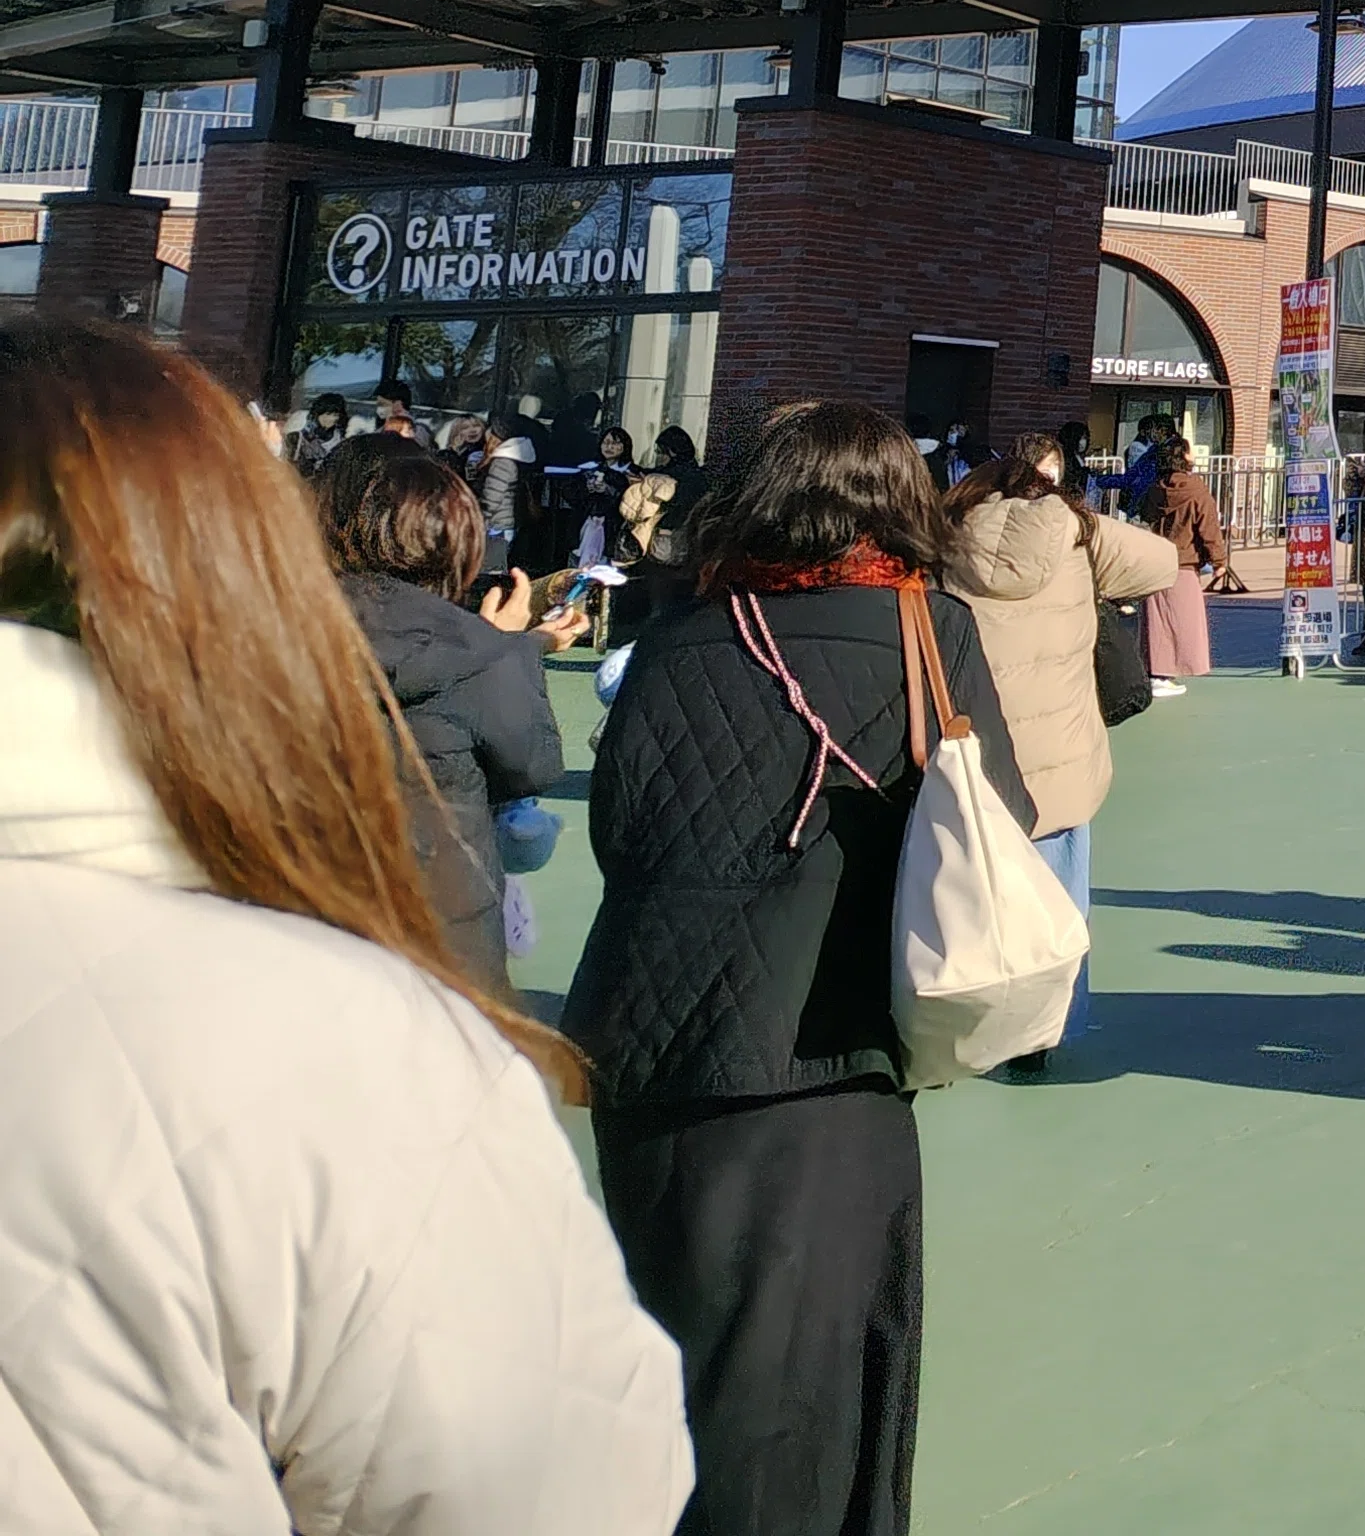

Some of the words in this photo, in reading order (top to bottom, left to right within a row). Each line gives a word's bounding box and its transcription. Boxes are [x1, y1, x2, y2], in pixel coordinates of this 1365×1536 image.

[405, 213, 496, 250] GATE
[400, 246, 646, 292] INFORMATION
[1091, 357, 1150, 376] STORE
[1153, 360, 1209, 379] FLAGS
